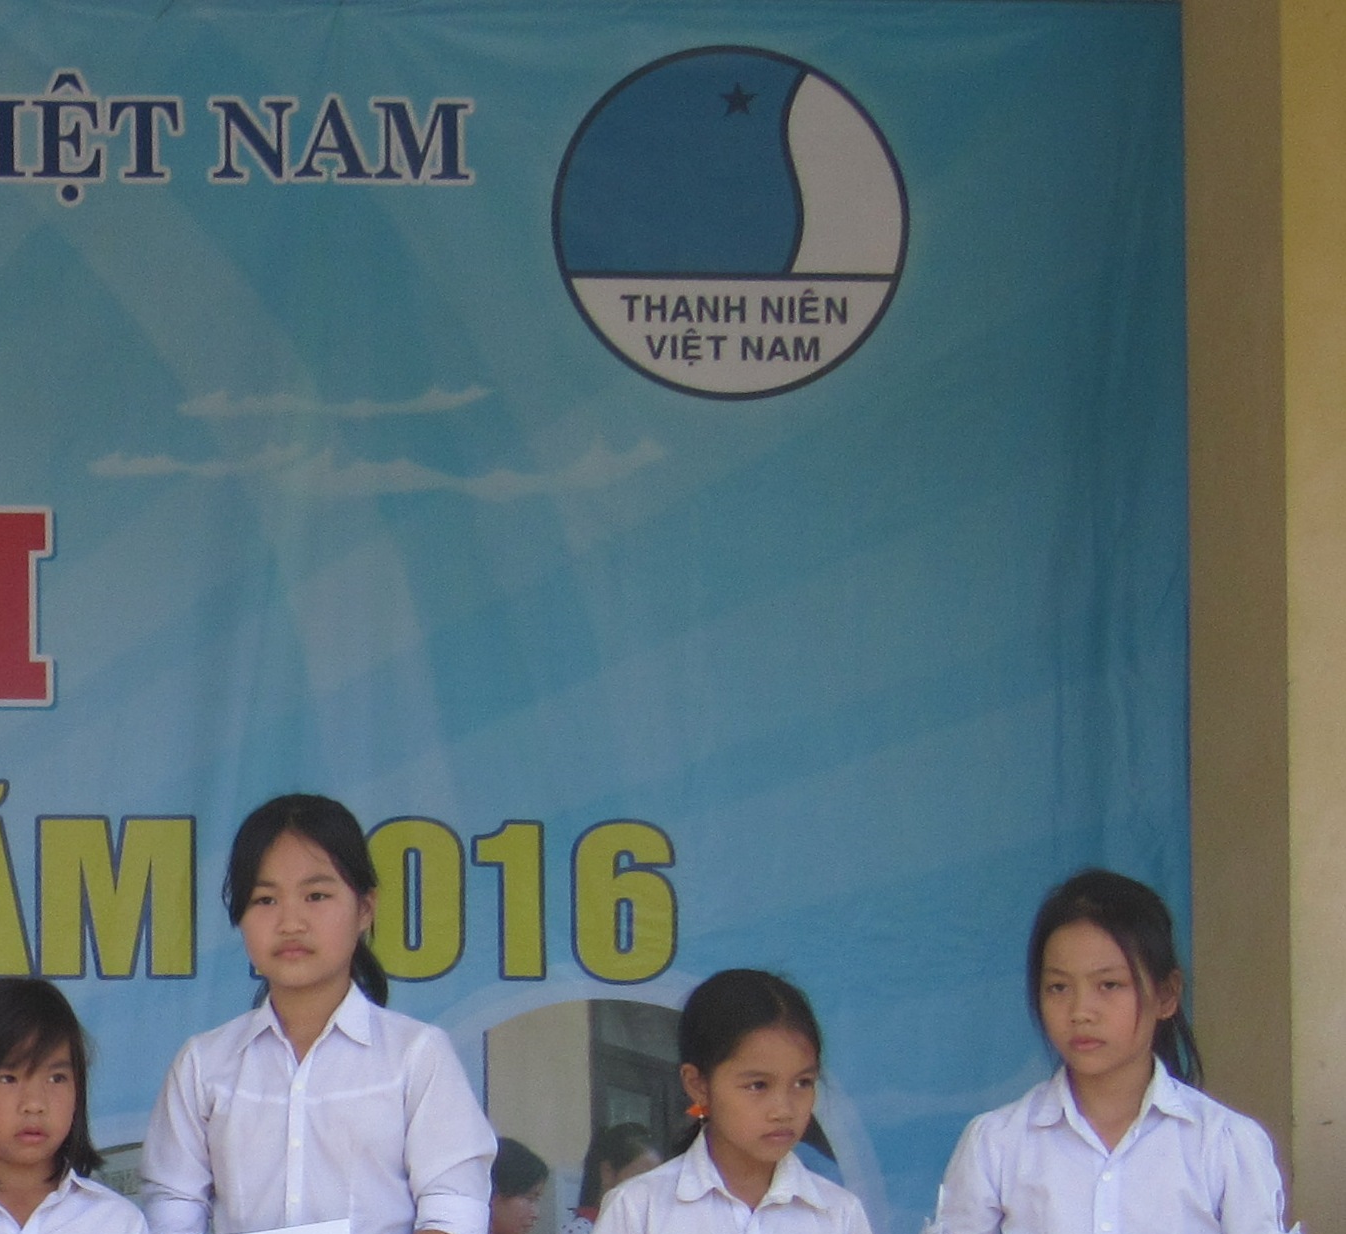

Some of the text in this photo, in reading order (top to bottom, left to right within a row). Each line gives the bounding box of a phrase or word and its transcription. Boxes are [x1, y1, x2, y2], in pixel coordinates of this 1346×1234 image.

[211, 99, 470, 180] NAM
[620, 288, 849, 325] THANH NIÊN
[646, 328, 821, 366] VIỆT NAM
[250, 815, 679, 986] 016
